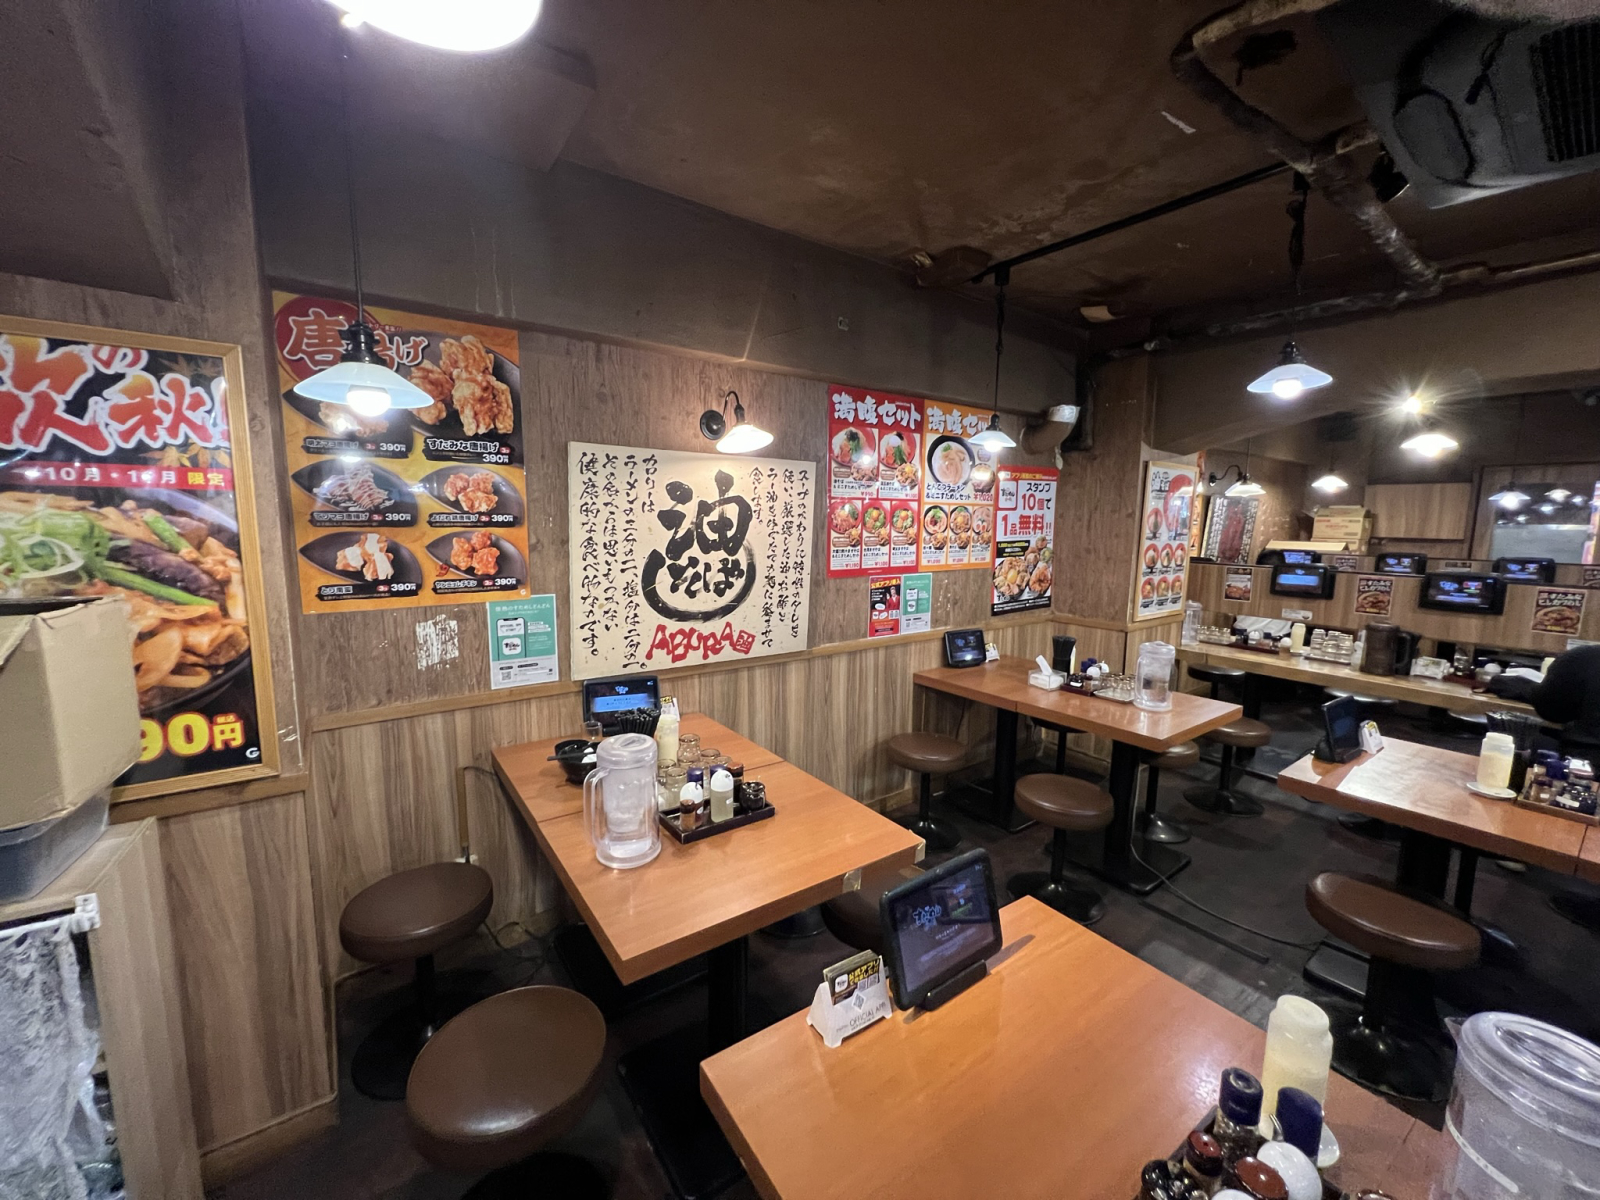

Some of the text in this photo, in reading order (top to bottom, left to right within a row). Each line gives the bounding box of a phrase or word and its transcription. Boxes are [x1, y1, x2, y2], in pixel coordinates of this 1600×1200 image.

[832, 391, 921, 430] 満腹セット
[927, 405, 992, 437] 満腹セッ
[427, 438, 499, 453] すたみな唐揚げ
[188, 471, 225, 486] 限定
[642, 454, 658, 513] カロリーは
[657, 469, 753, 561] 油
[1022, 493, 1052, 510] 10個で
[667, 556, 745, 598] そば
[645, 621, 736, 664] ABURA
